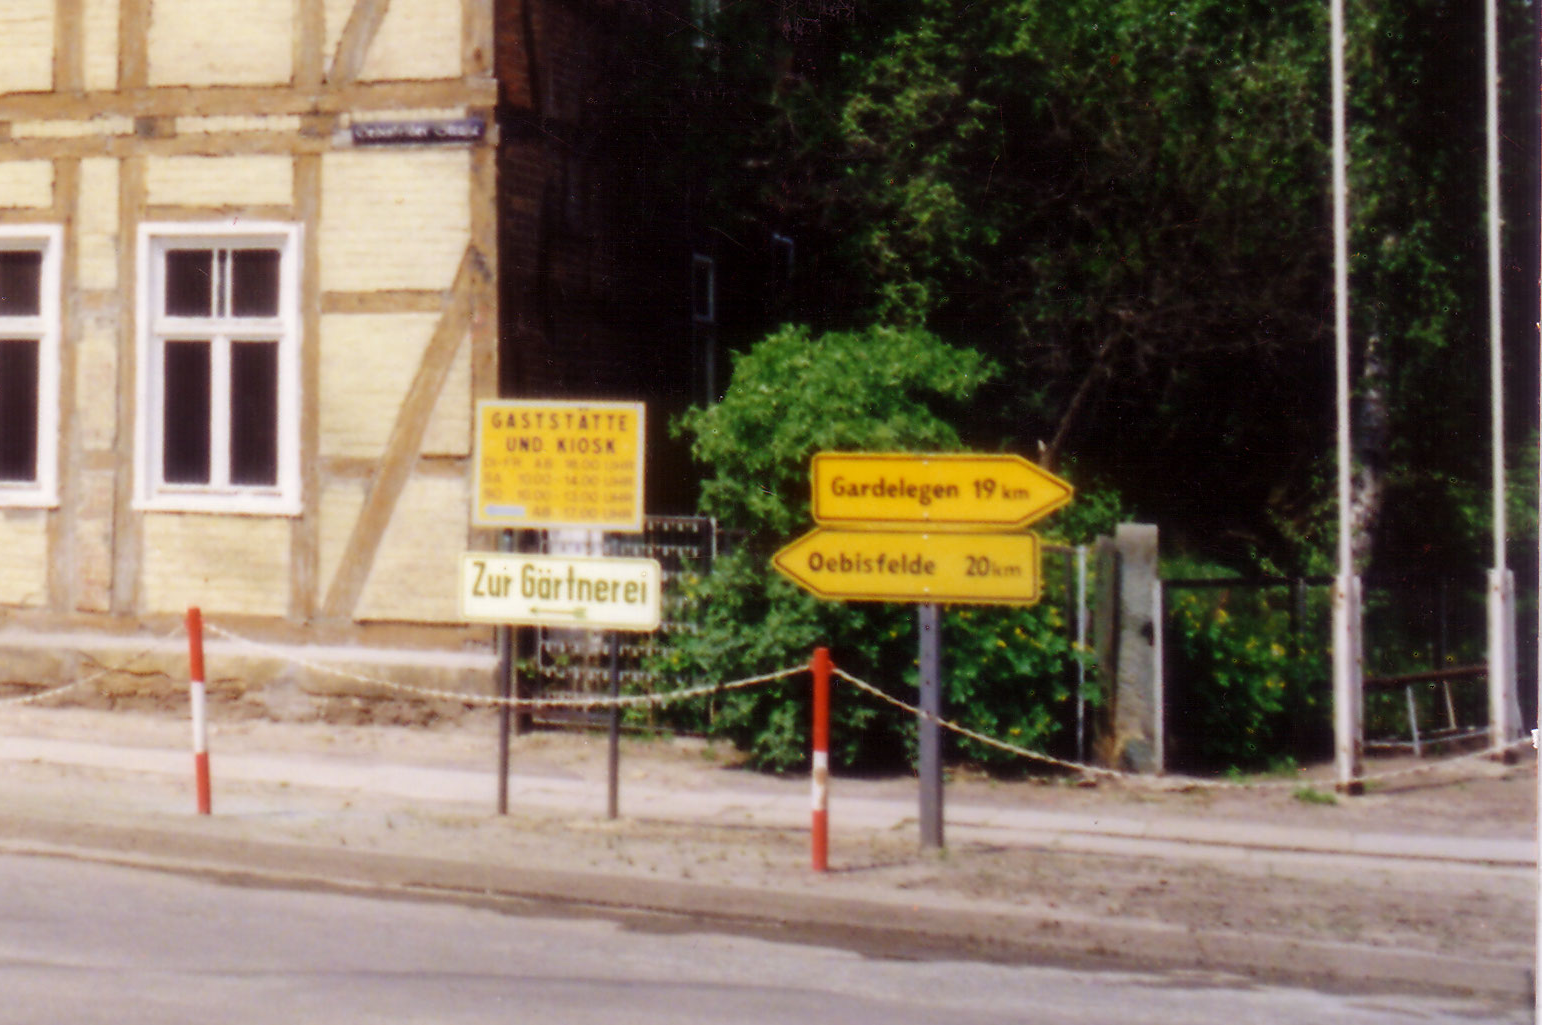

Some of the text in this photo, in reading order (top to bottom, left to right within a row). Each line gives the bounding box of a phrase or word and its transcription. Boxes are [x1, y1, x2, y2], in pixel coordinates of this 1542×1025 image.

[491, 407, 628, 432] GASTSTÄTTE
[507, 437, 615, 454] UND KIOSK
[831, 476, 1030, 506] Gardelegen 19 km
[808, 551, 1022, 577] Oebisfelde 20 km
[471, 561, 648, 605] Zur Gärtnerei
